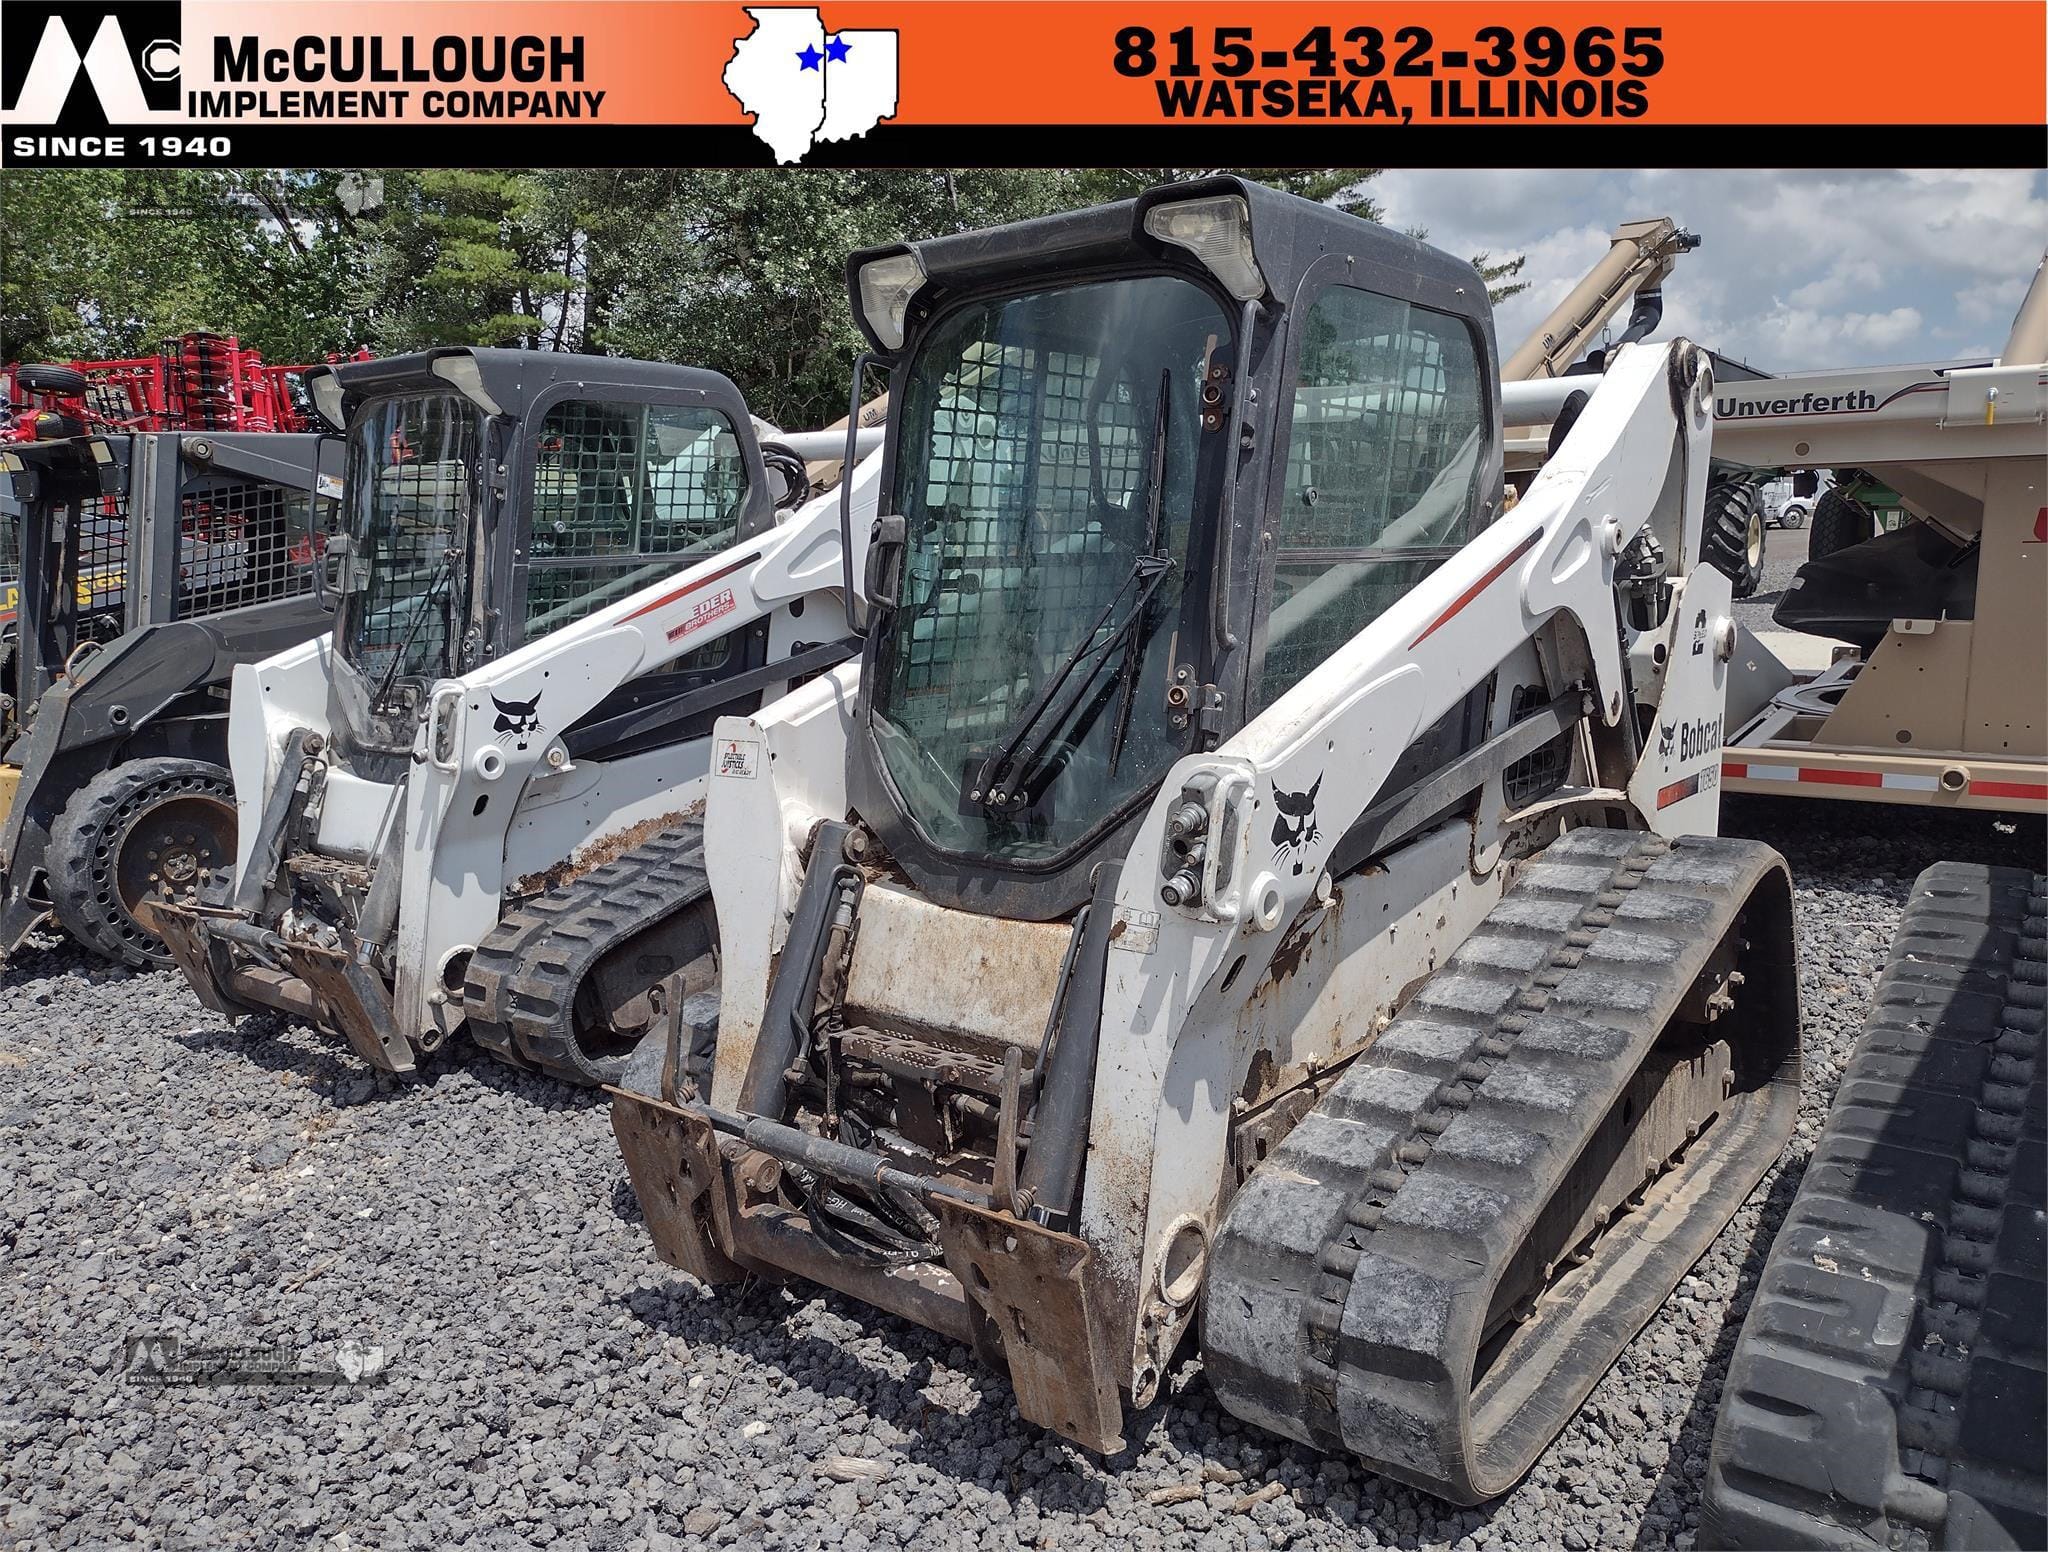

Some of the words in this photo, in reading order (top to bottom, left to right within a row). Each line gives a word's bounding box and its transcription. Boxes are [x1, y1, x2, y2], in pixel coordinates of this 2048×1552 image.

[1717, 390, 1875, 417] Unverferth
[685, 602, 730, 631] BROTHERS
[1680, 713, 1722, 762] Bobcat
